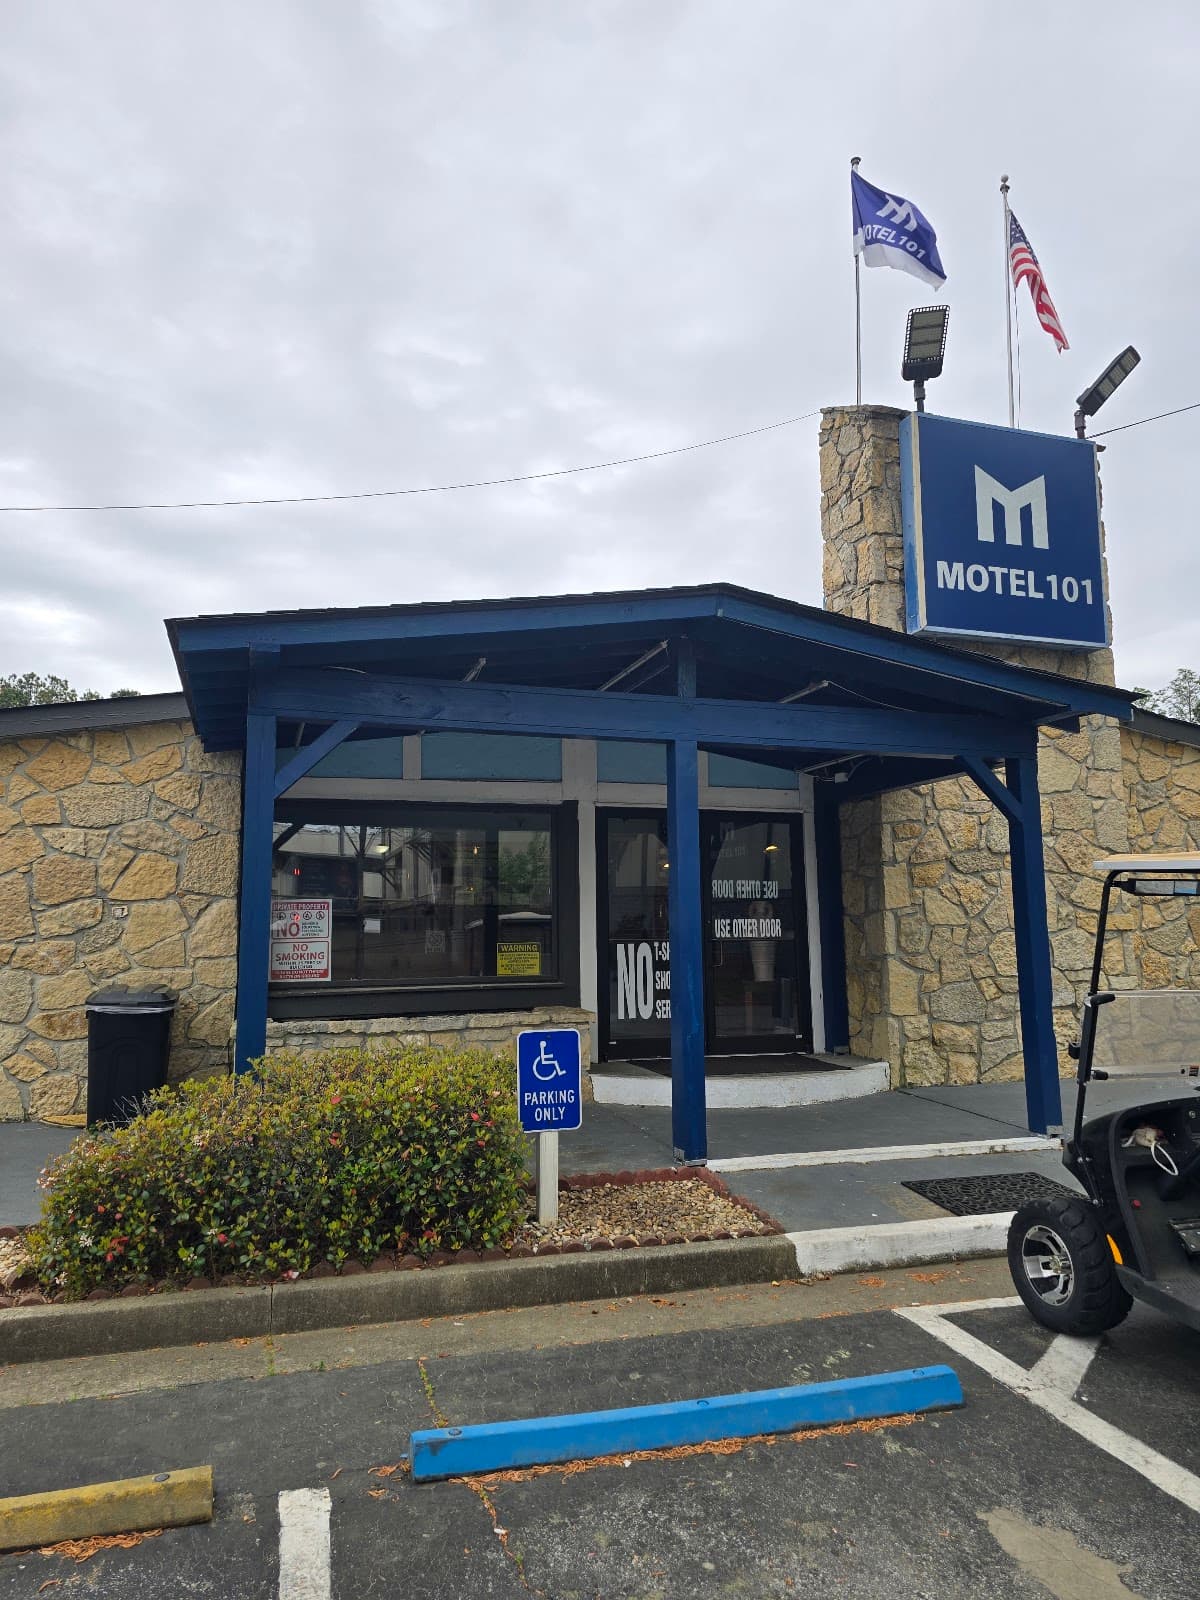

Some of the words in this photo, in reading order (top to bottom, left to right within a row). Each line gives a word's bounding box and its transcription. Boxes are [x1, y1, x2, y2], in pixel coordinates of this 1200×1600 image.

[899, 235, 926, 259] 101
[974, 464, 1049, 550] M
[936, 560, 1044, 599] MOTEL
[1046, 574, 1093, 605] 101
[276, 922, 300, 937] NO
[714, 919, 731, 938] USE
[732, 919, 758, 938] OTHER
[760, 919, 782, 937] DOOR
[275, 952, 325, 961] SMOKING
[292, 944, 308, 952] NO
[616, 942, 654, 1020] NO
[524, 1089, 575, 1106] PARKING
[534, 1106, 566, 1122] ONLY
